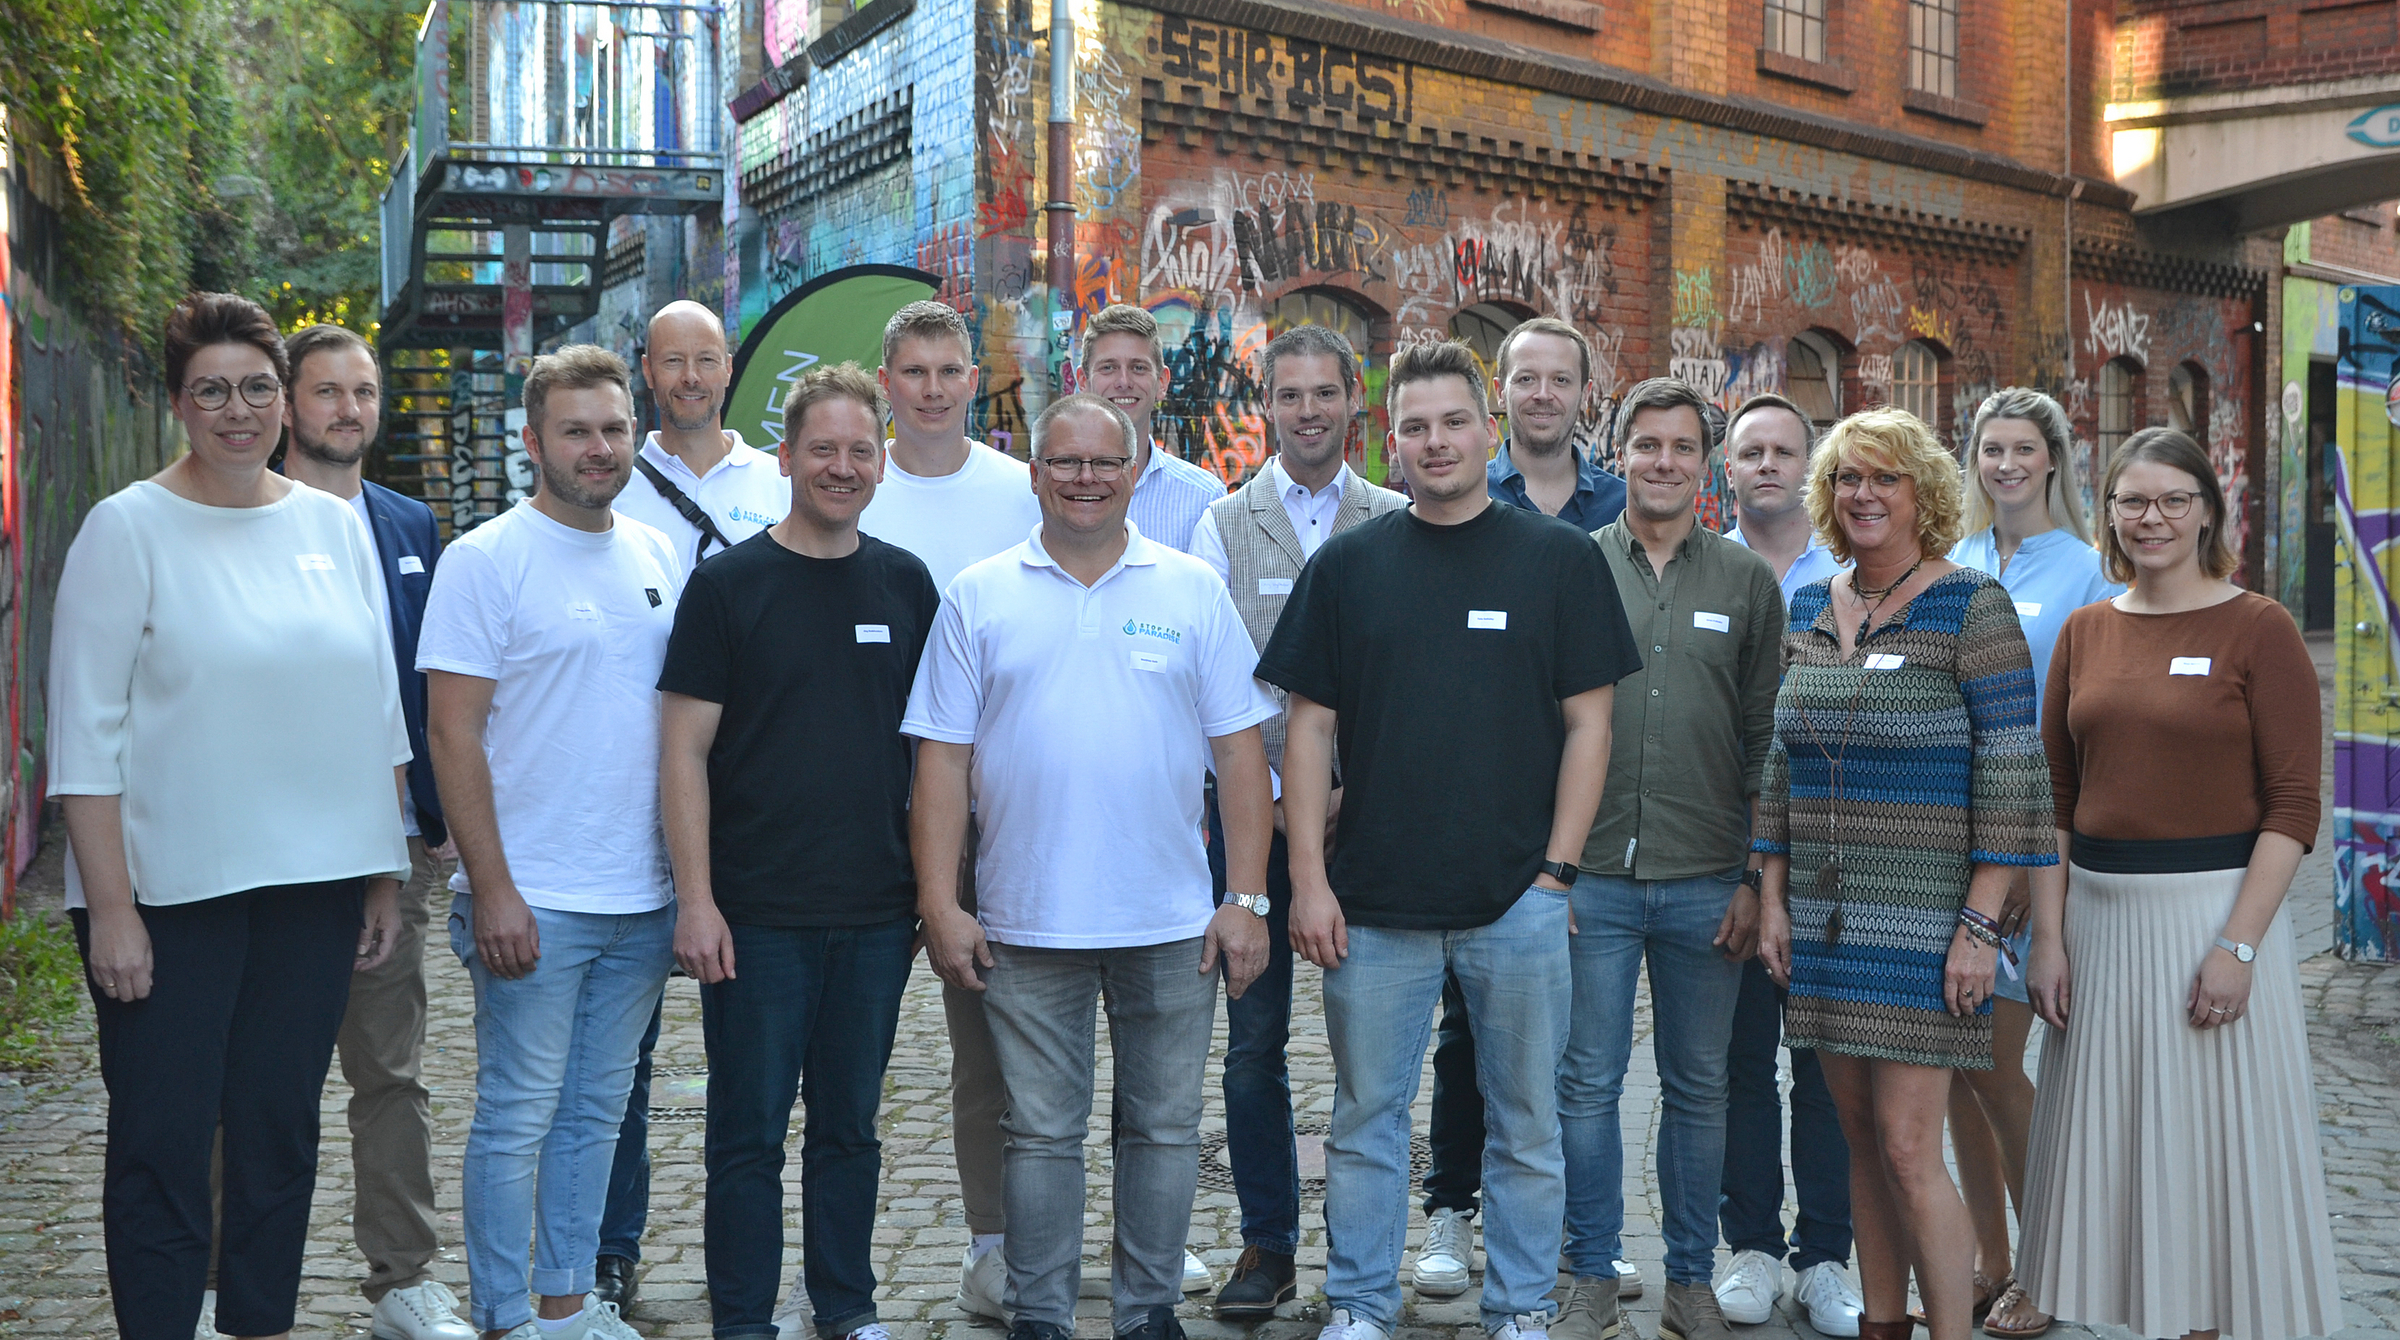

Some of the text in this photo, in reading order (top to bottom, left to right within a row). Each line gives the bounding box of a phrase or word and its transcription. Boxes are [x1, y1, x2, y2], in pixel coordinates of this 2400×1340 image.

[1139, 627, 1181, 645] PARADISE
[1140, 622, 1181, 638] STOP FOR
